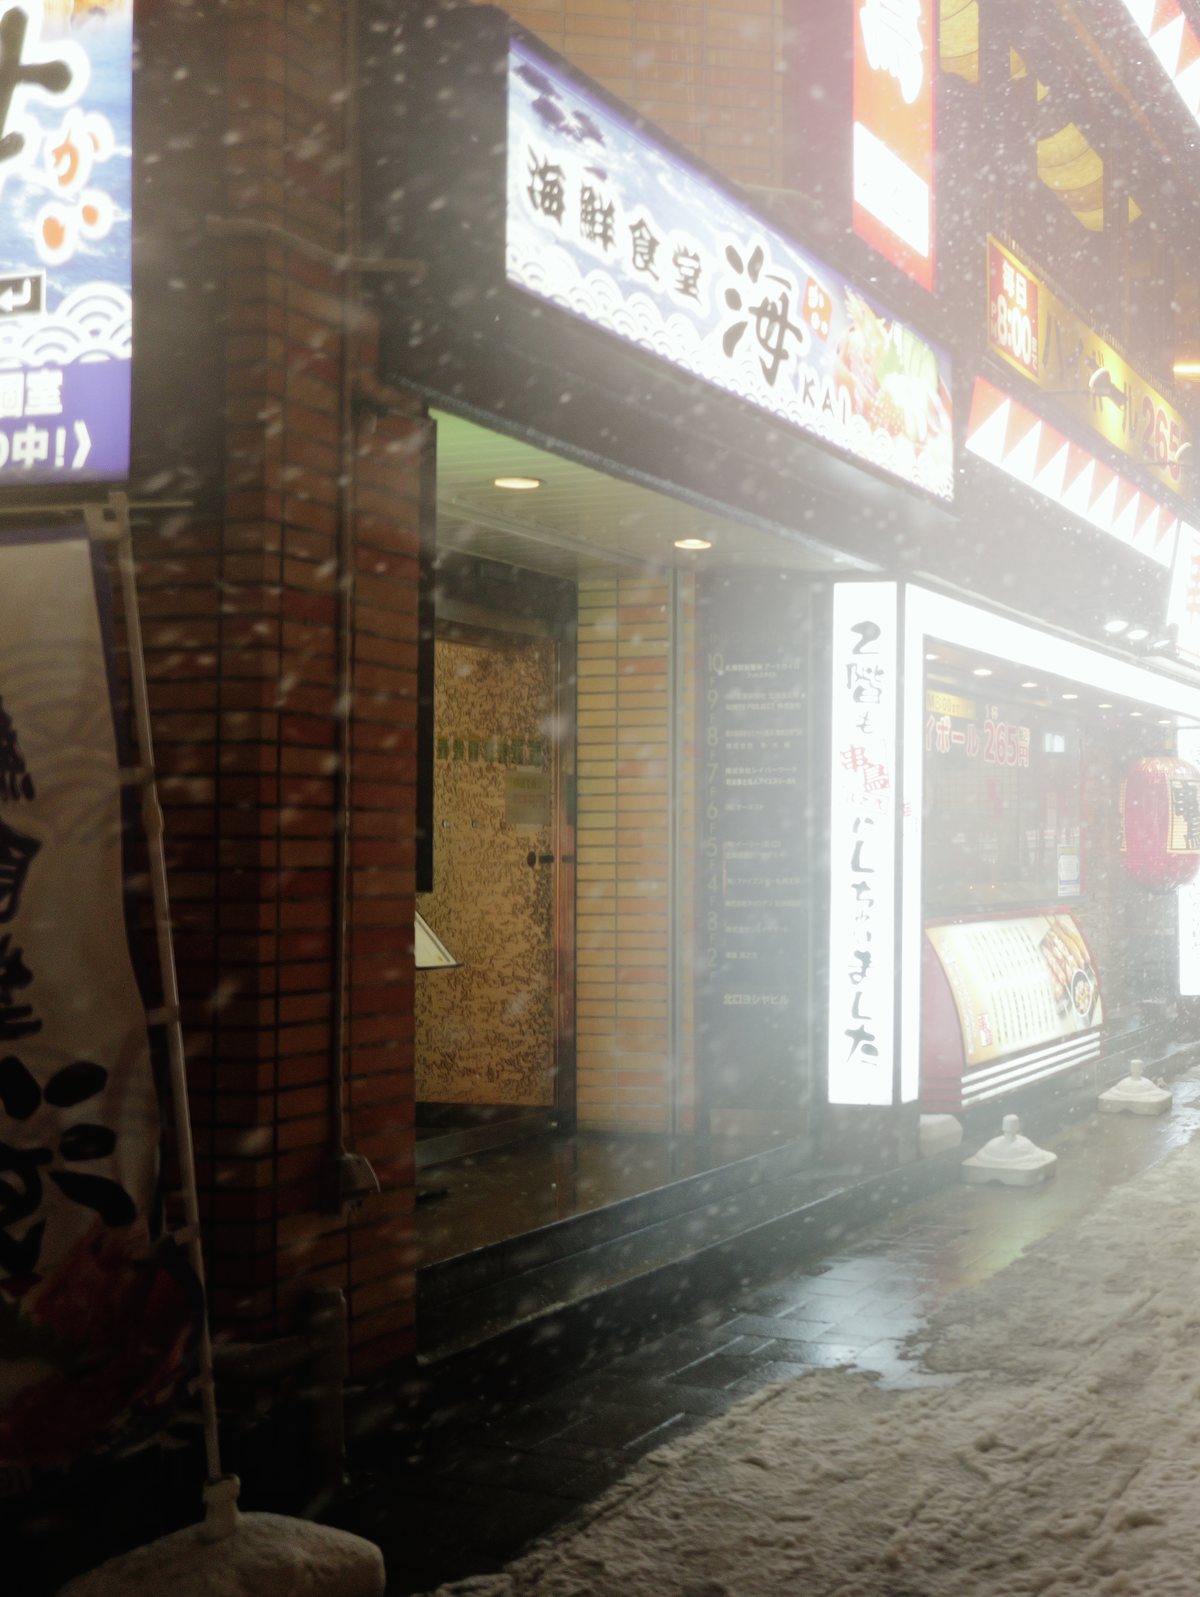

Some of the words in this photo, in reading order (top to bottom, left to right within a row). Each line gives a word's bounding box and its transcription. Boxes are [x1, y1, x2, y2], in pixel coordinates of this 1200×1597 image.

[527, 145, 702, 304] 海鮮食堂
[722, 245, 803, 387] 海
[1003, 258, 1028, 310] 毎日
[997, 294, 1032, 365] 8:00
[801, 374, 849, 424] KAI
